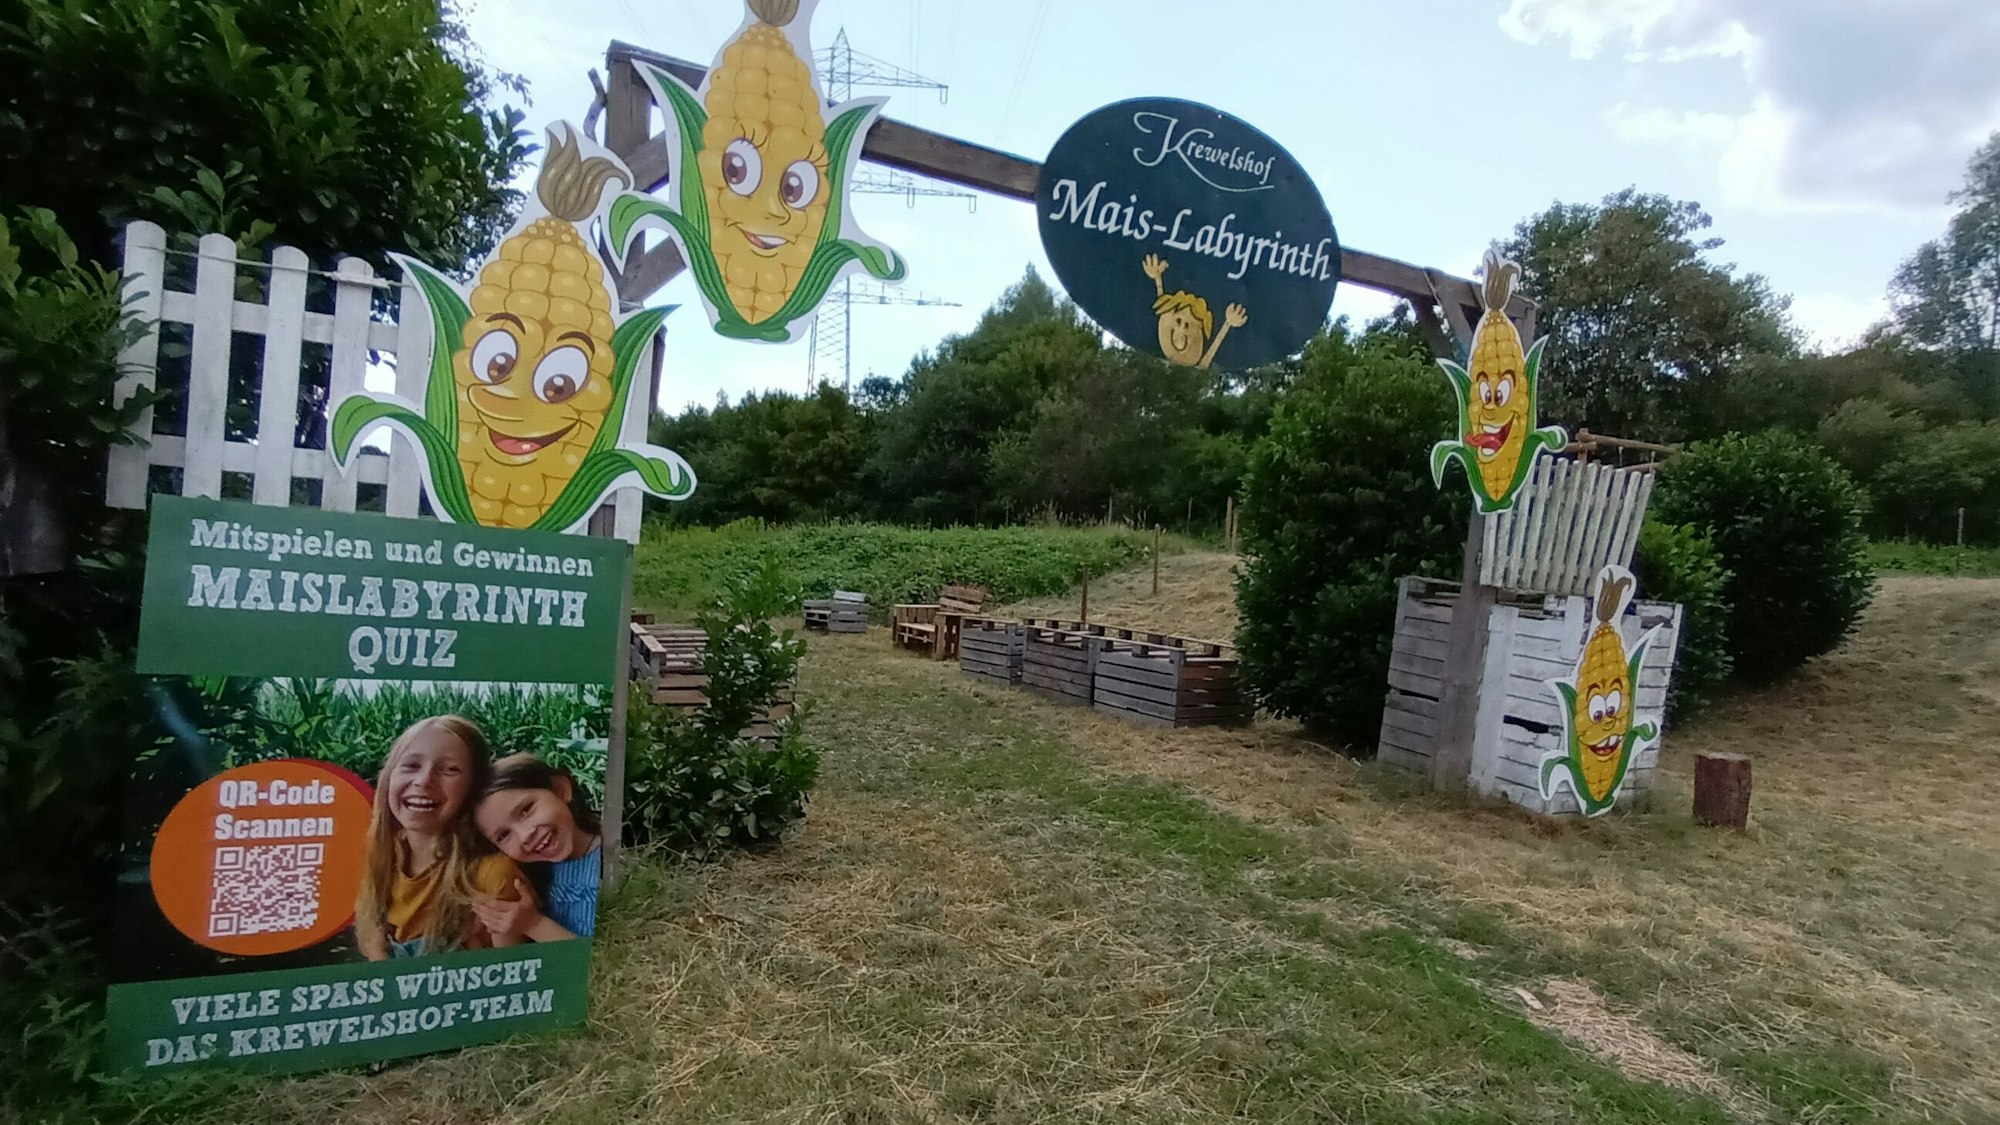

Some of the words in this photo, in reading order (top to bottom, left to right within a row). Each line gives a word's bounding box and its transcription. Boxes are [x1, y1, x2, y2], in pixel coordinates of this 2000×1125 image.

[1133, 111, 1275, 192] Krewelshof
[1050, 179, 1332, 281] Mais-Labyrinth
[190, 518, 373, 562] Mitspielen
[386, 540, 442, 566] und
[453, 543, 594, 577] Gewinnen
[187, 565, 588, 628] MAISLABYRINTH
[348, 625, 459, 674] QUIZ
[219, 779, 335, 809] QR-Code
[214, 813, 333, 840] Scannen
[171, 988, 281, 1026] VIELE
[291, 977, 385, 1013] SPASS
[396, 958, 543, 1000] WÜNSCHT
[145, 1033, 219, 1068] DAS
[228, 989, 555, 1058] KREWELSHOF-TEAM
